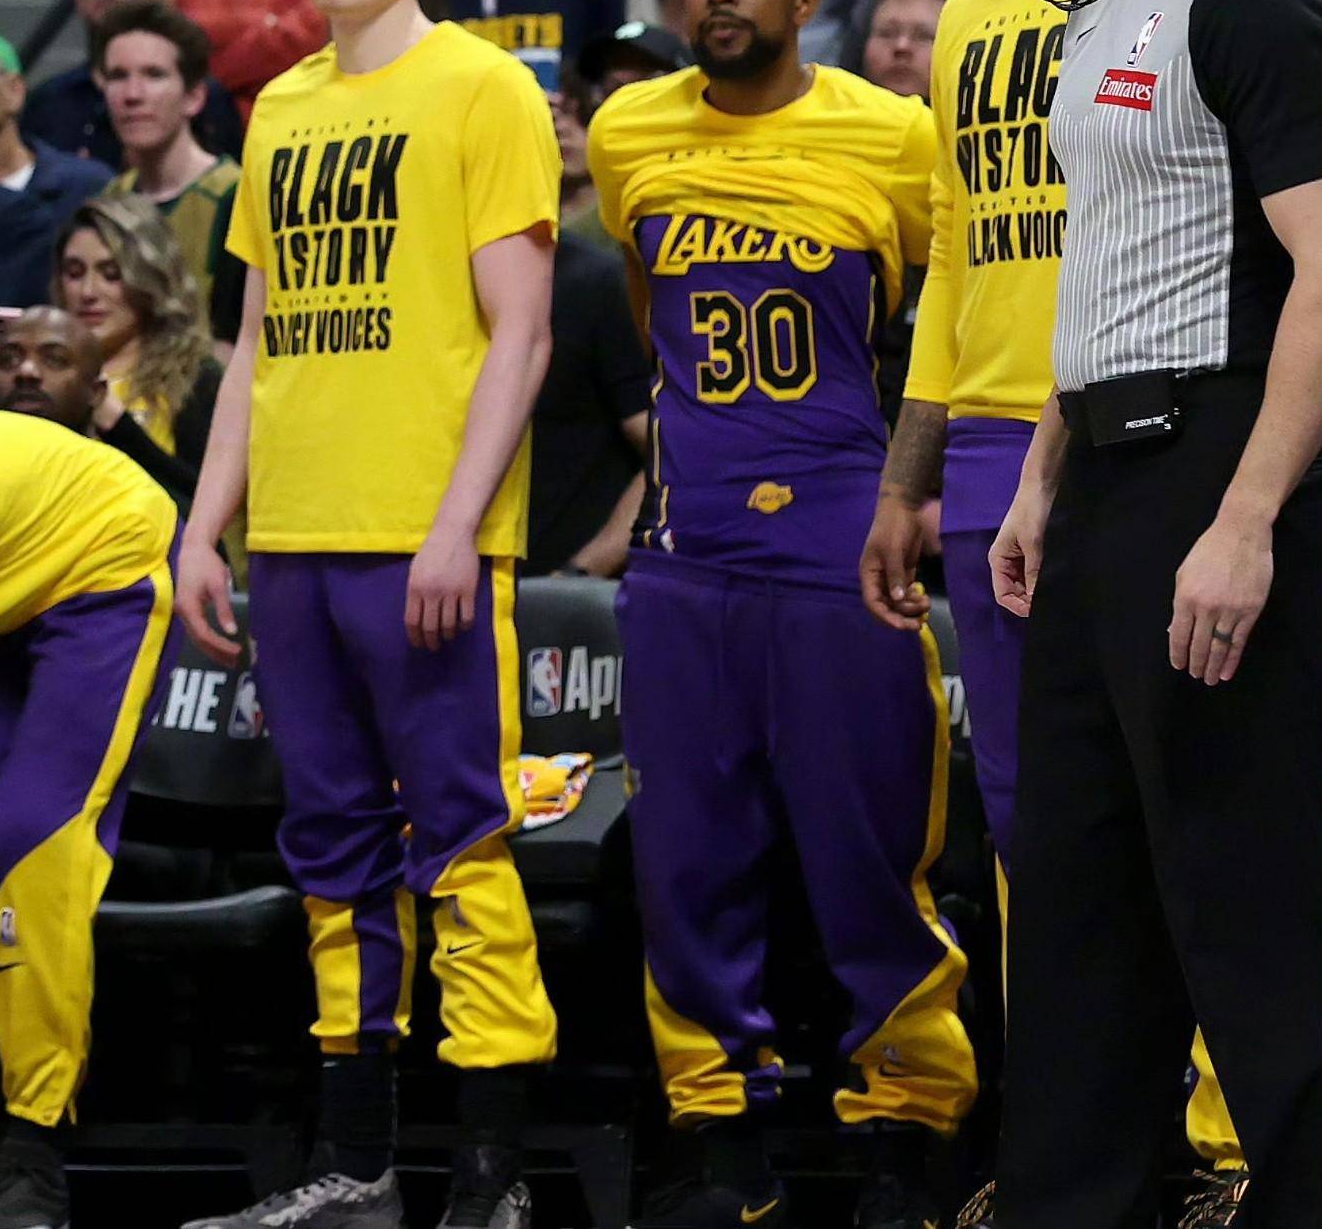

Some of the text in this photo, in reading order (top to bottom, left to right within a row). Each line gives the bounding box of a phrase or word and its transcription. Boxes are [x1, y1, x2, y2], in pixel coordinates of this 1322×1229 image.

[957, 23, 1067, 131] BLAC
[1100, 76, 1153, 101] Emirates
[271, 134, 409, 233] BLACK
[690, 288, 818, 404] 30
[152, 667, 227, 732] HE
